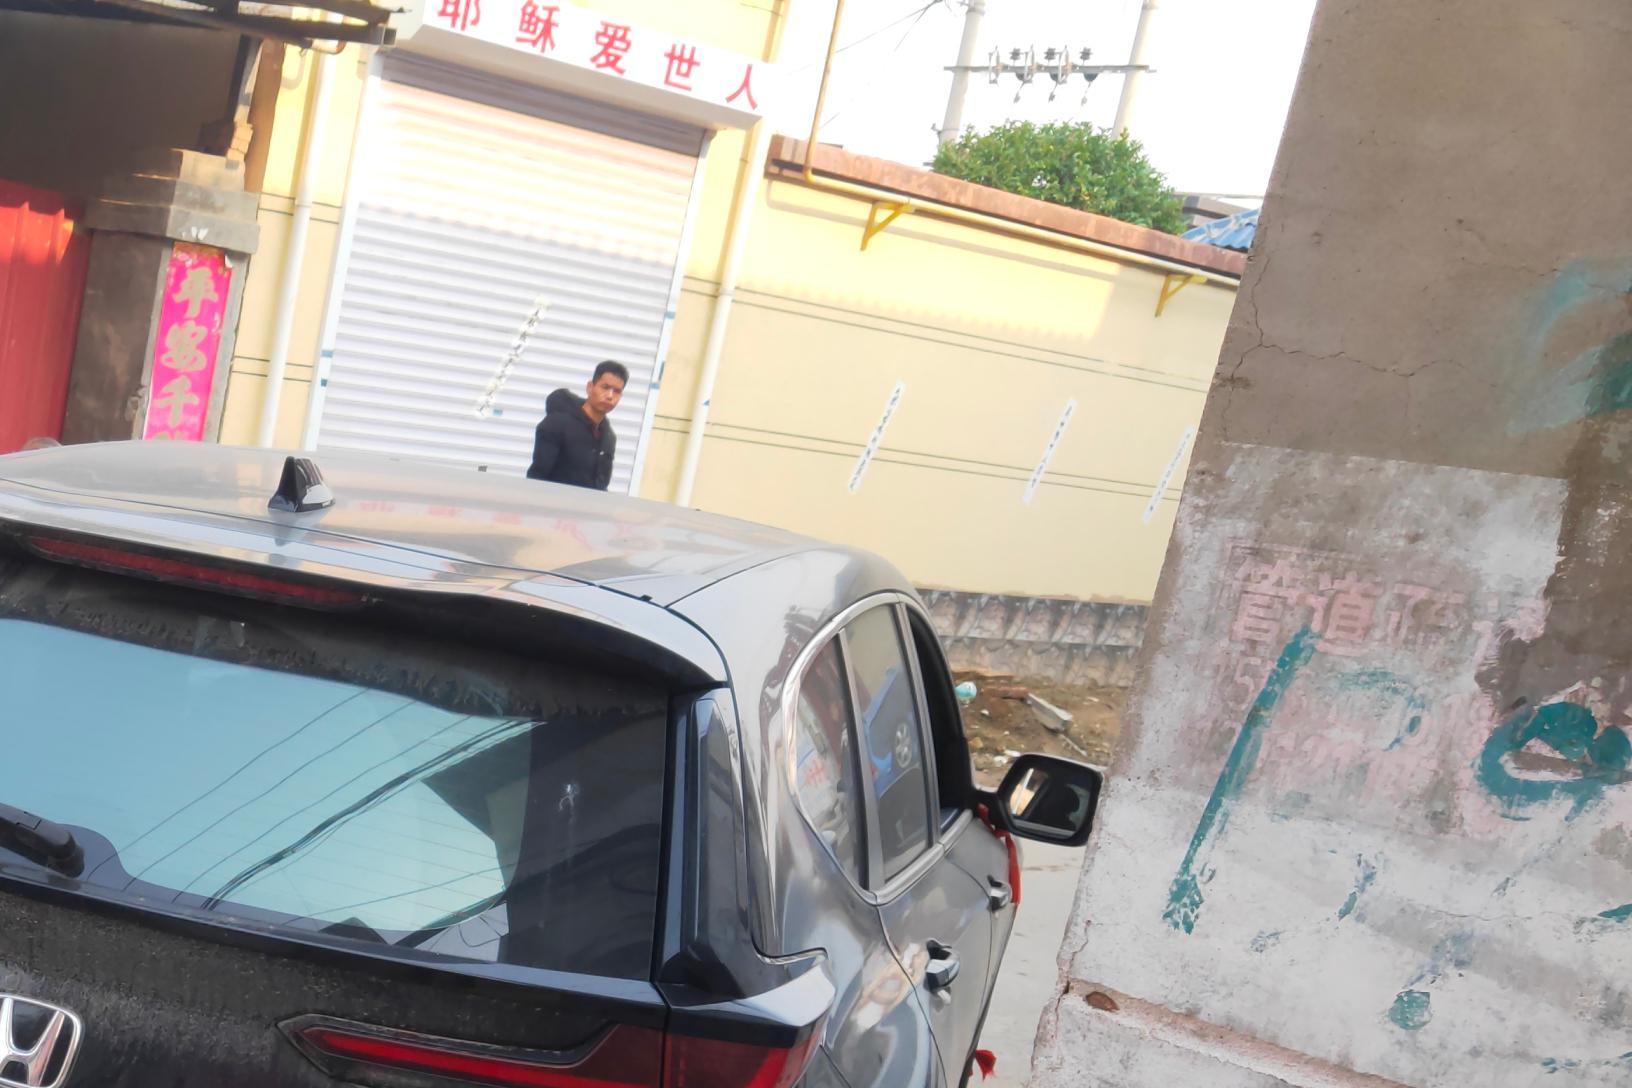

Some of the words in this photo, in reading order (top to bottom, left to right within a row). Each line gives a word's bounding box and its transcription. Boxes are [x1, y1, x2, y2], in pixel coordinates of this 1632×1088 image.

[437, 0, 758, 110] 耶稣爱世人
[154, 266, 219, 441] 平安千
